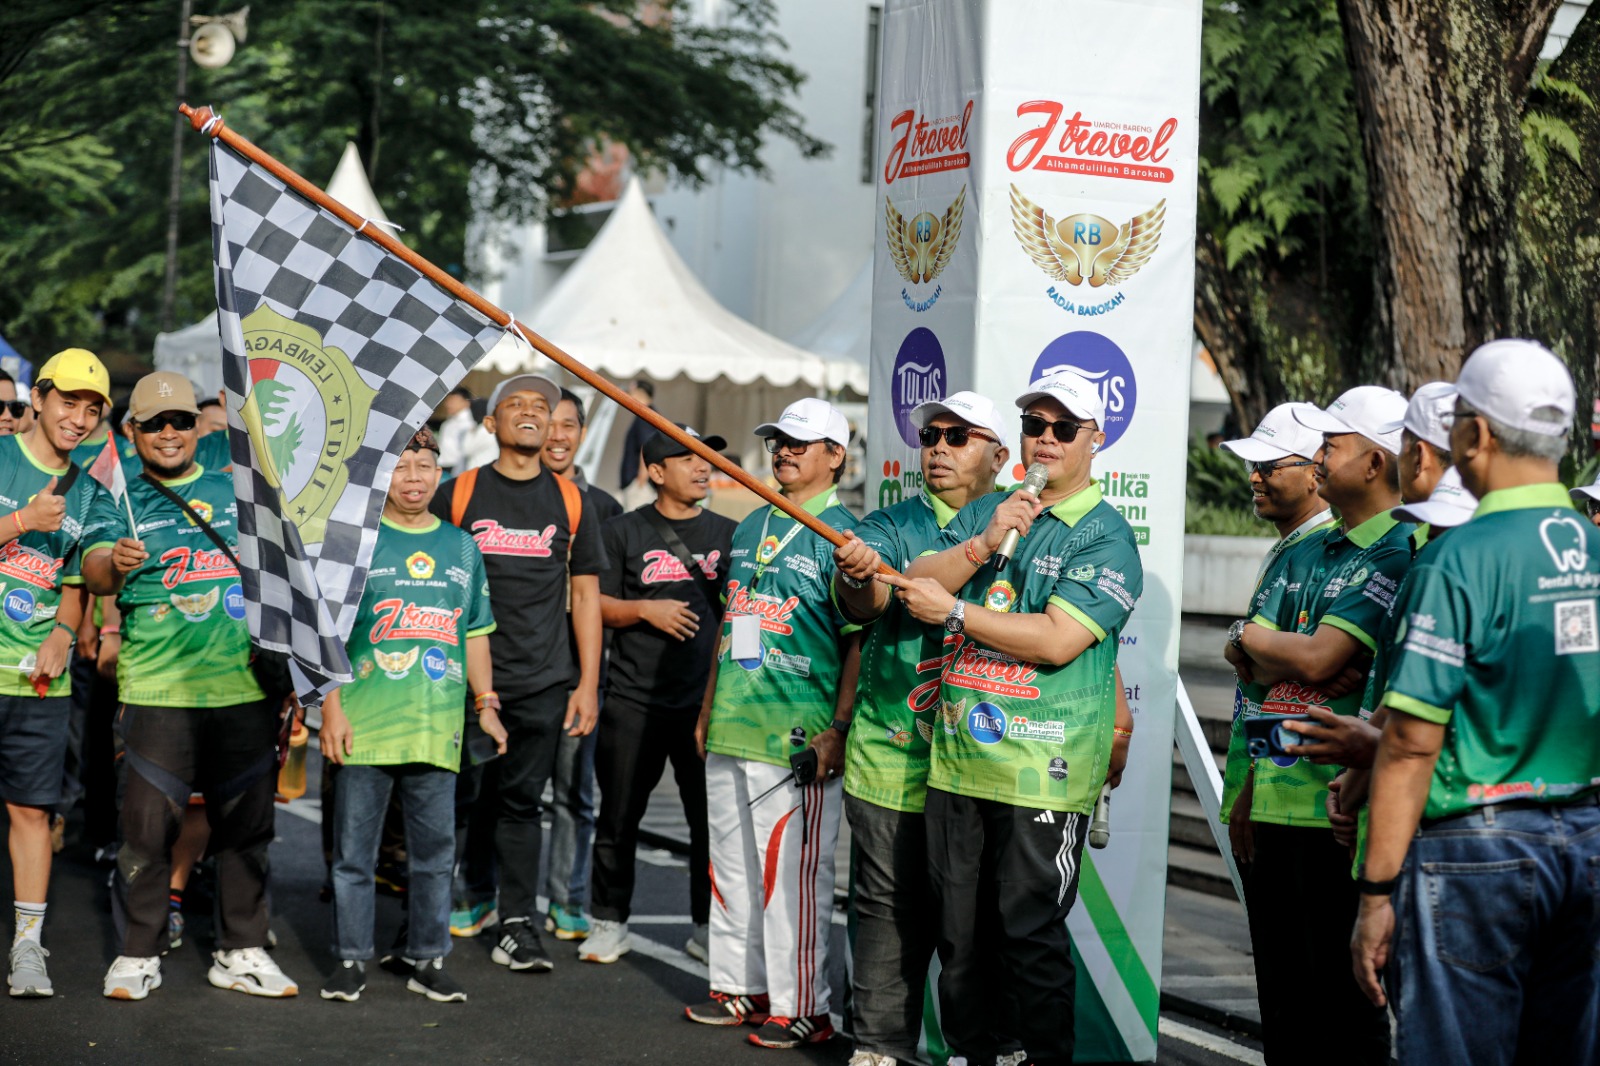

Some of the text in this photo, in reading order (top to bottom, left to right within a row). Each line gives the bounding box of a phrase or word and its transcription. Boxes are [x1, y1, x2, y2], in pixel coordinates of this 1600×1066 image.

[1093, 120, 1153, 134] UMROH BARENG
[904, 155, 967, 174] Alhamdulillah Barokah
[1046, 159, 1166, 179] Alhamdulillah Barokah
[916, 220, 931, 244] RB
[1073, 221, 1102, 245] RB
[916, 284, 943, 313] BAROKAH
[1045, 285, 1126, 317] RADJA BAROKAH
[157, 379, 173, 398] LA
[897, 362, 941, 406] TULUS
[993, 685, 1033, 697] Barokah
[972, 712, 1003, 732] TULUS
[1028, 720, 1064, 731] medika
